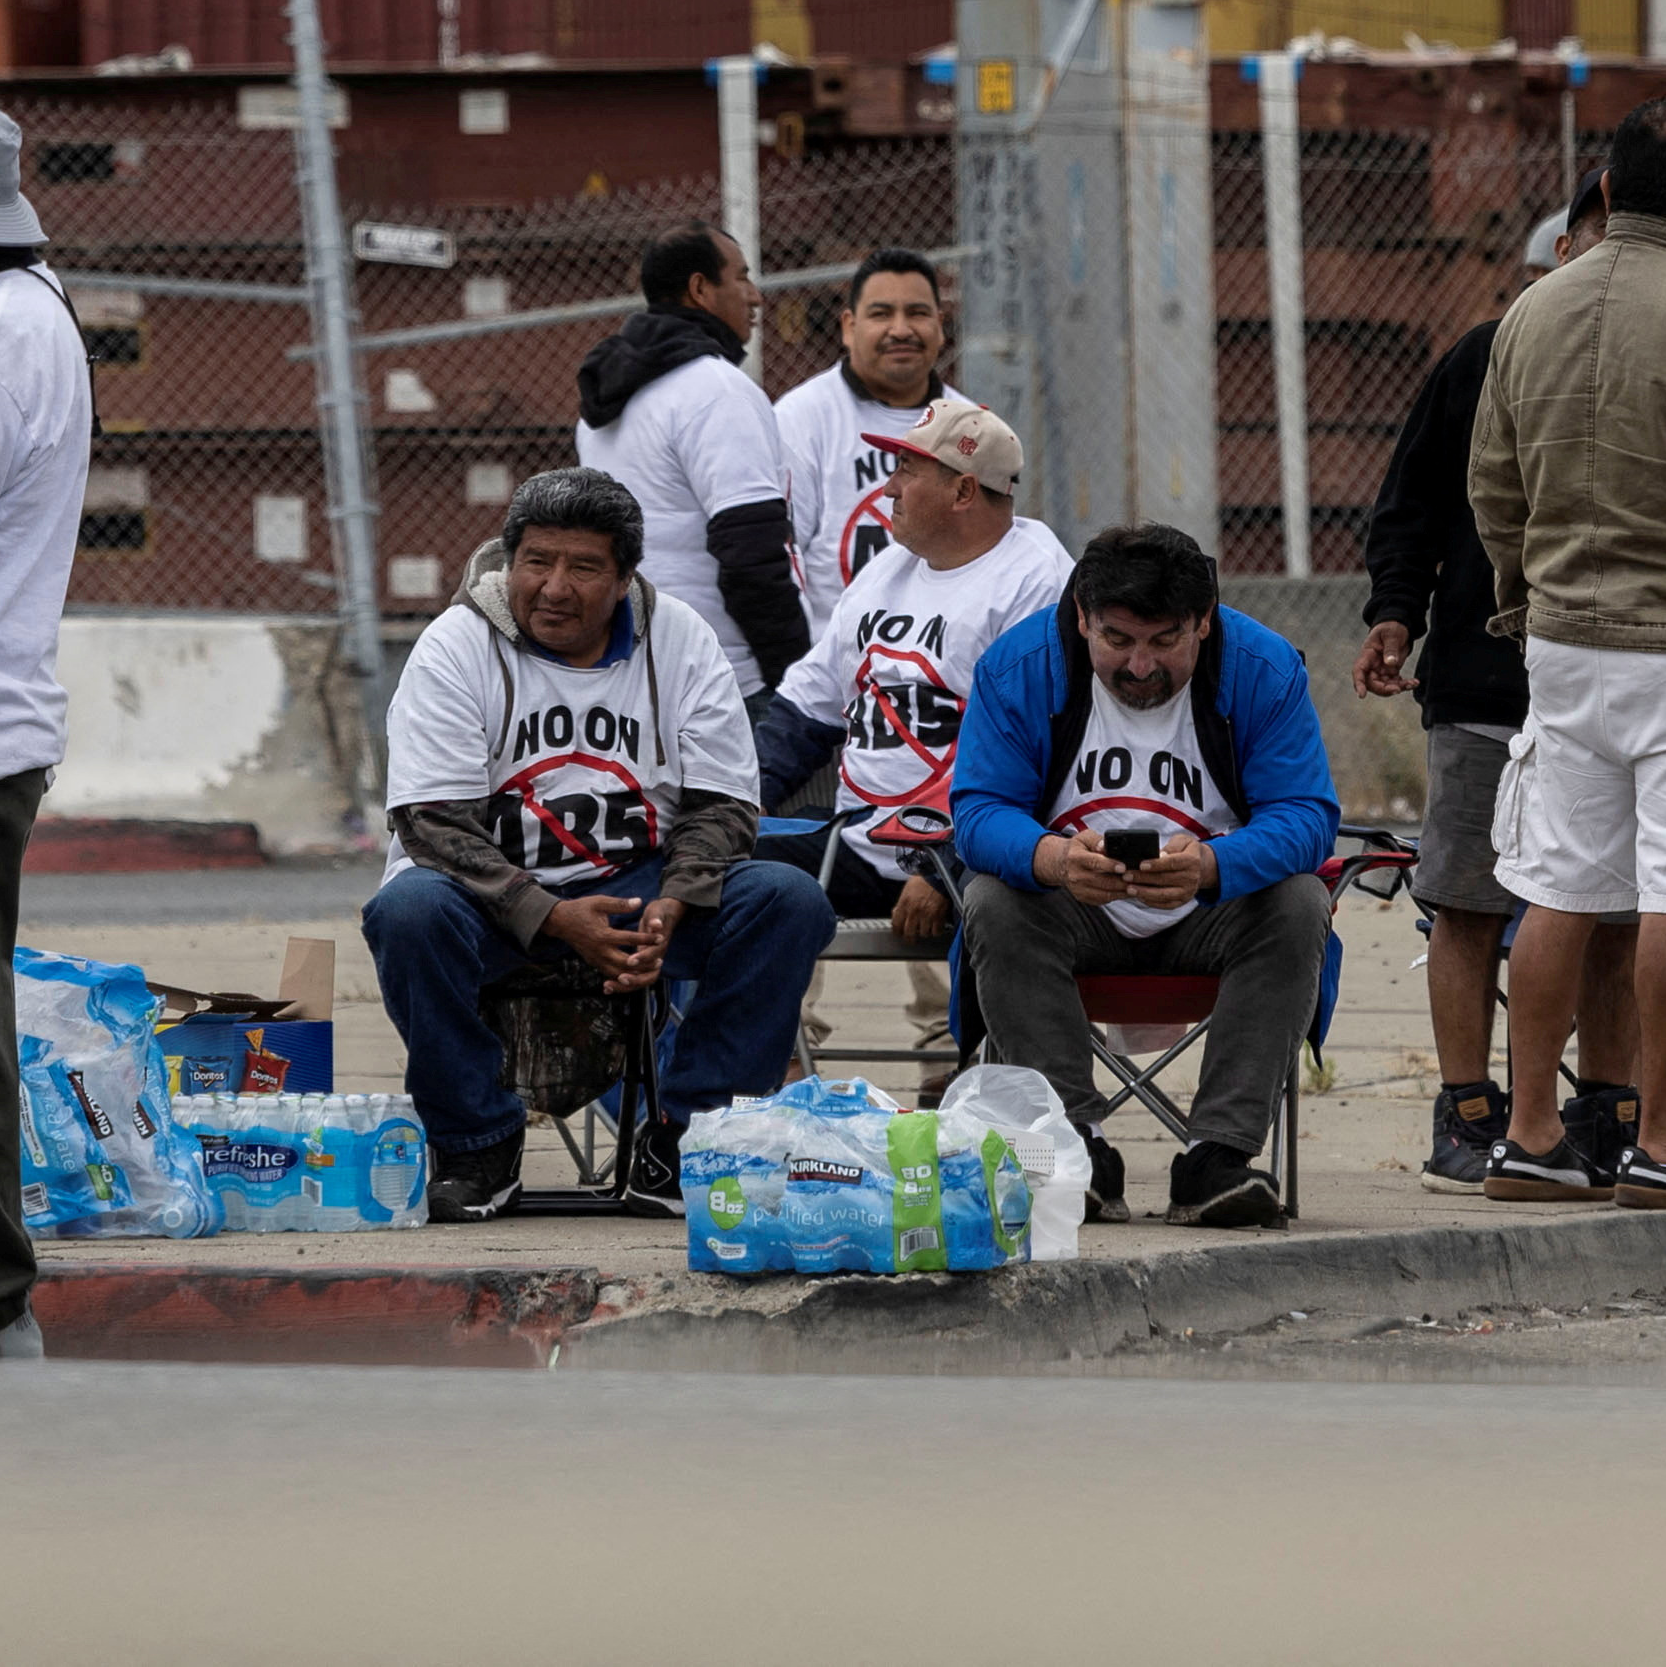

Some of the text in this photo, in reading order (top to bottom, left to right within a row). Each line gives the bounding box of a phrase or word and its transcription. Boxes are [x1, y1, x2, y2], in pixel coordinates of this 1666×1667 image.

[856, 609, 915, 653] NO
[512, 705, 640, 765] NO ON
[1076, 746, 1204, 812] NO ON
[193, 1071, 225, 1082] Doritos
[250, 1070, 279, 1085] Doritos
[205, 1145, 286, 1169] refreshe
[790, 1159, 861, 1178] KIRKLAND
[830, 1206, 886, 1228] water
